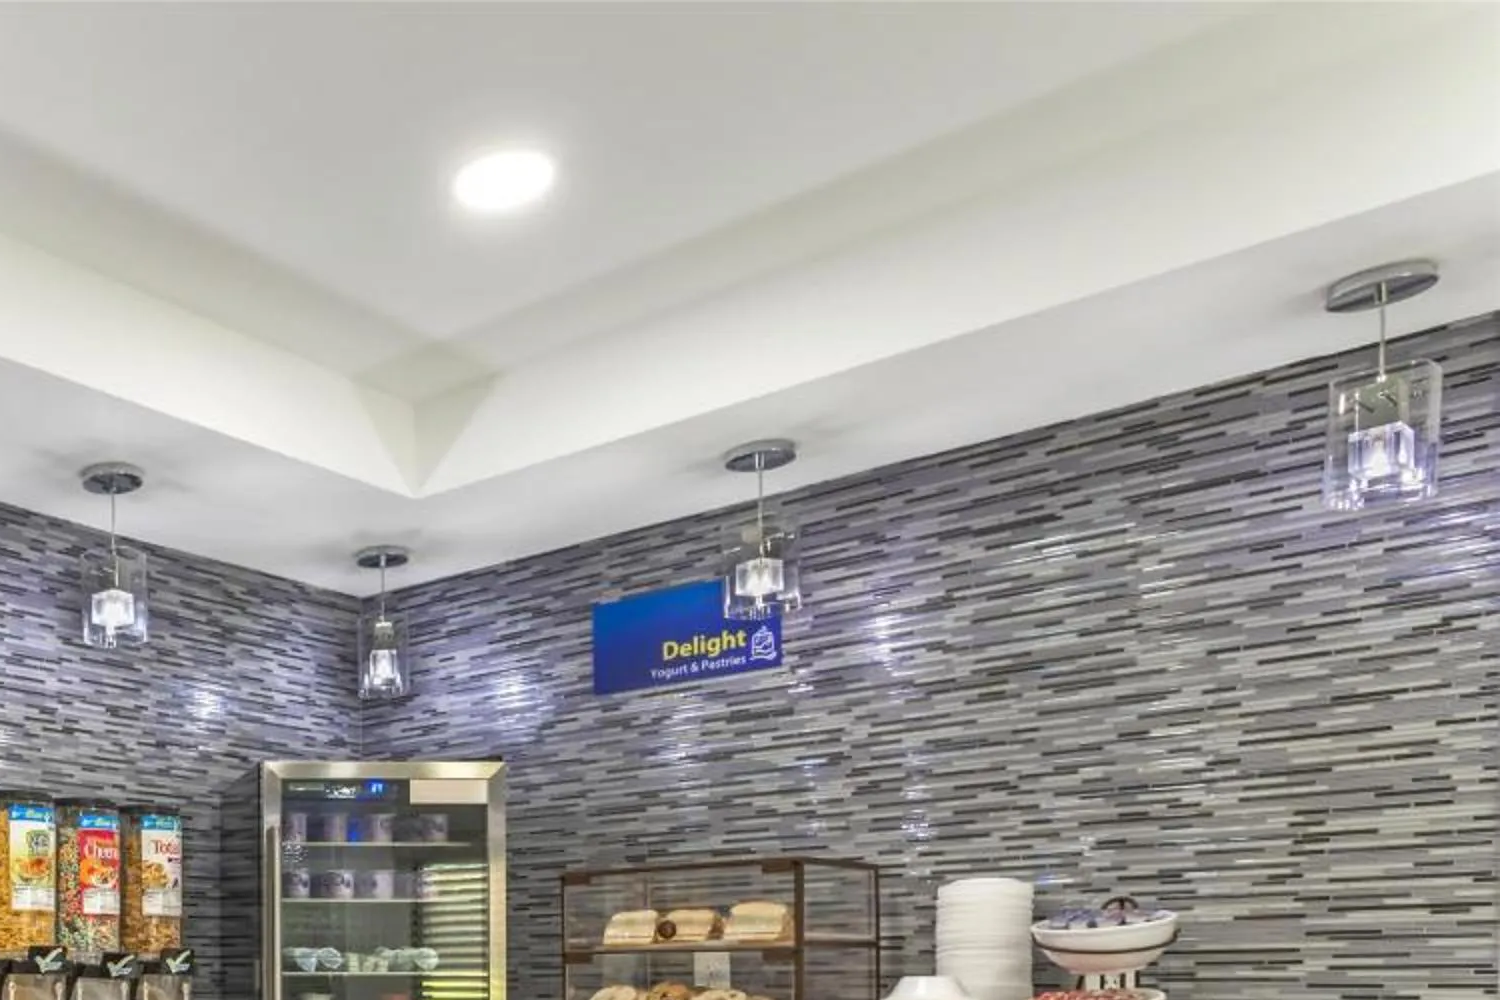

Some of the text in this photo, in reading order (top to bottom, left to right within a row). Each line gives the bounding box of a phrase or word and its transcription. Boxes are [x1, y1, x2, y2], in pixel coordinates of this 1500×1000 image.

[662, 629, 748, 661] Delight
[651, 655, 746, 679] Yogurt & Pastries
